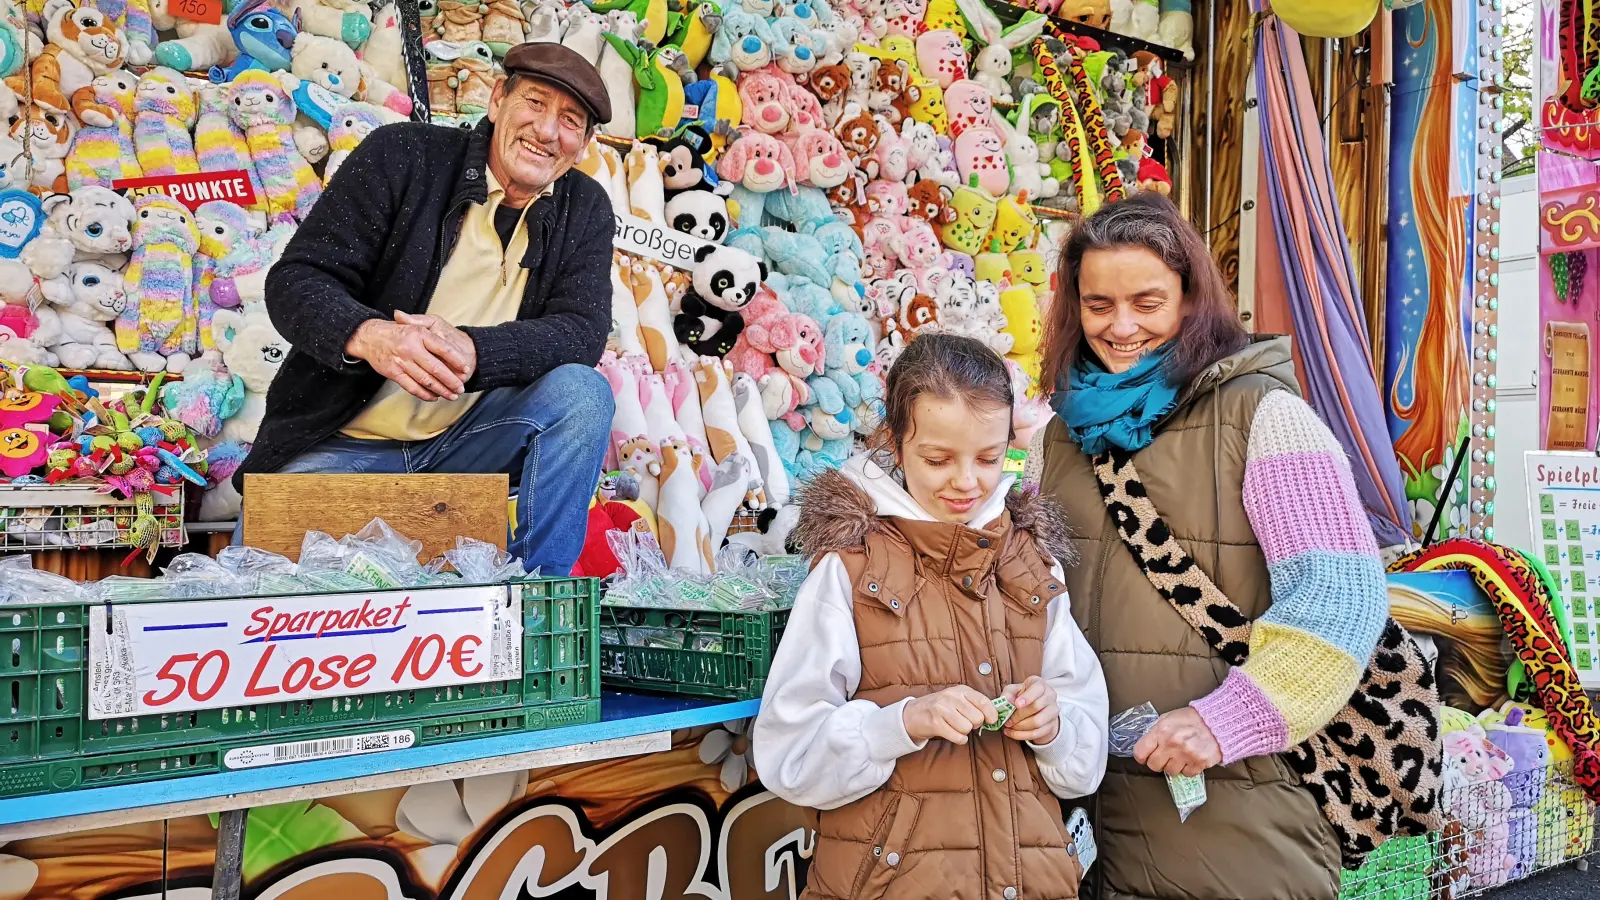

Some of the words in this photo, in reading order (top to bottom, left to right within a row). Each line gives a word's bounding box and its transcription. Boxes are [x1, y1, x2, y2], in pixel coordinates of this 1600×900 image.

[180, 0, 207, 16] 150
[168, 177, 248, 202] PUNKTE
[1572, 499, 1597, 510] Freie
[243, 596, 412, 641] Sparpaket
[504, 619, 511, 628] 25
[143, 649, 231, 707] 50
[244, 644, 378, 698] Lose
[390, 633, 484, 684] 10€
[392, 734, 411, 745] 186
